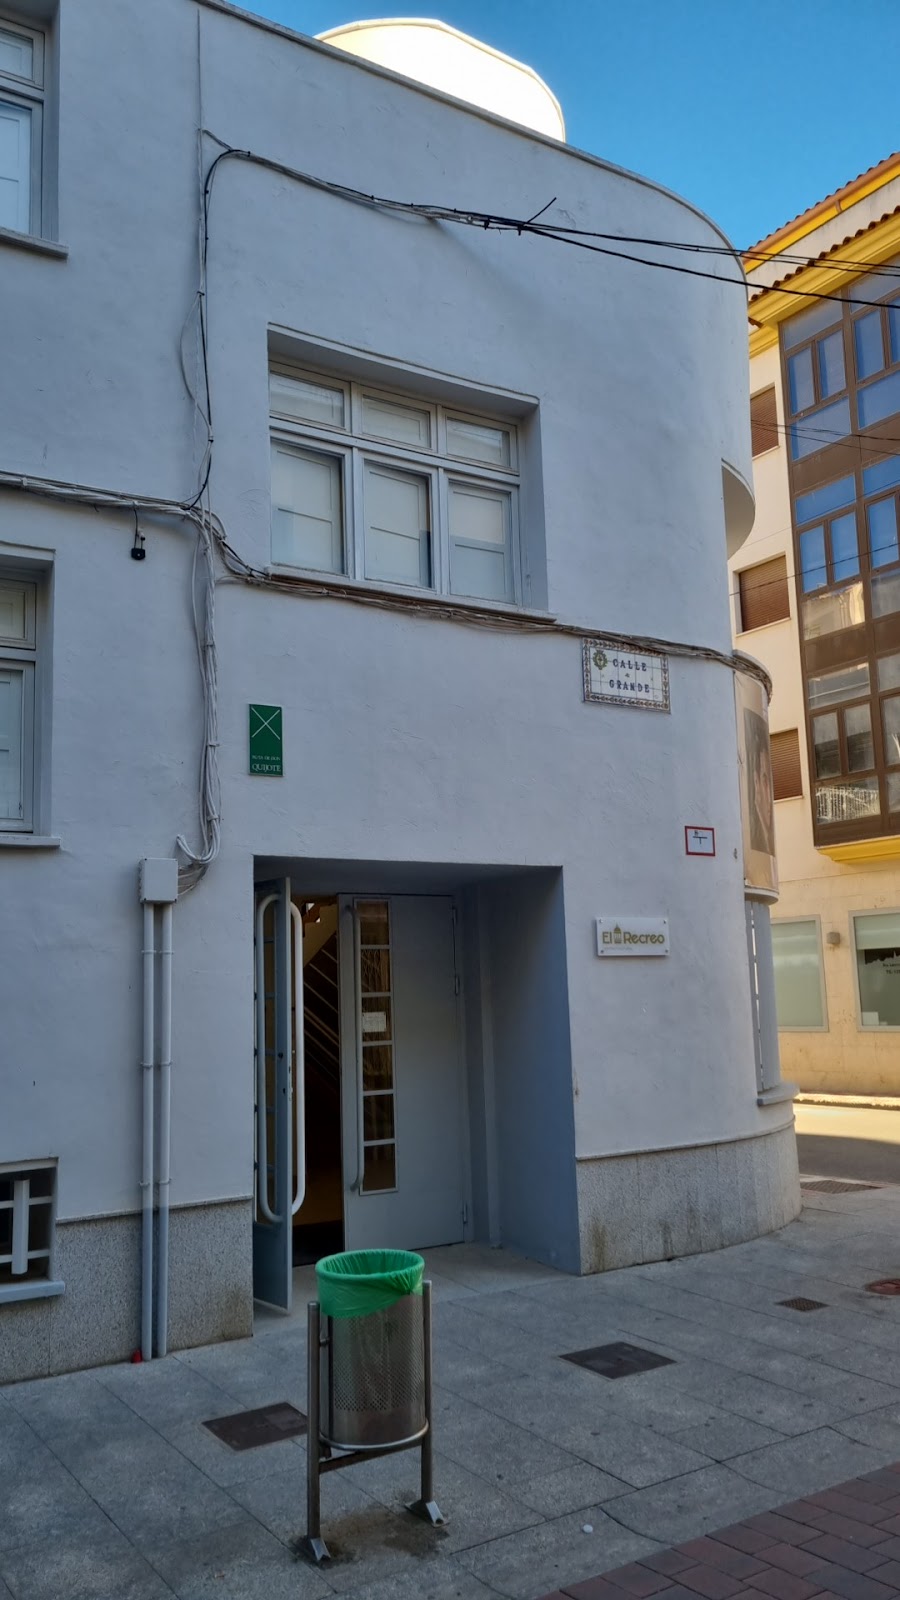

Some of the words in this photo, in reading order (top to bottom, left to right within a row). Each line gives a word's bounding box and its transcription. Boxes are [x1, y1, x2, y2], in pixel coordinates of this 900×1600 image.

[612, 658, 647, 672] CALLE
[609, 679, 650, 693] GRANDE
[251, 763, 282, 773] QUIJOTE
[602, 931, 612, 944] El
[623, 931, 665, 944] Recreo
